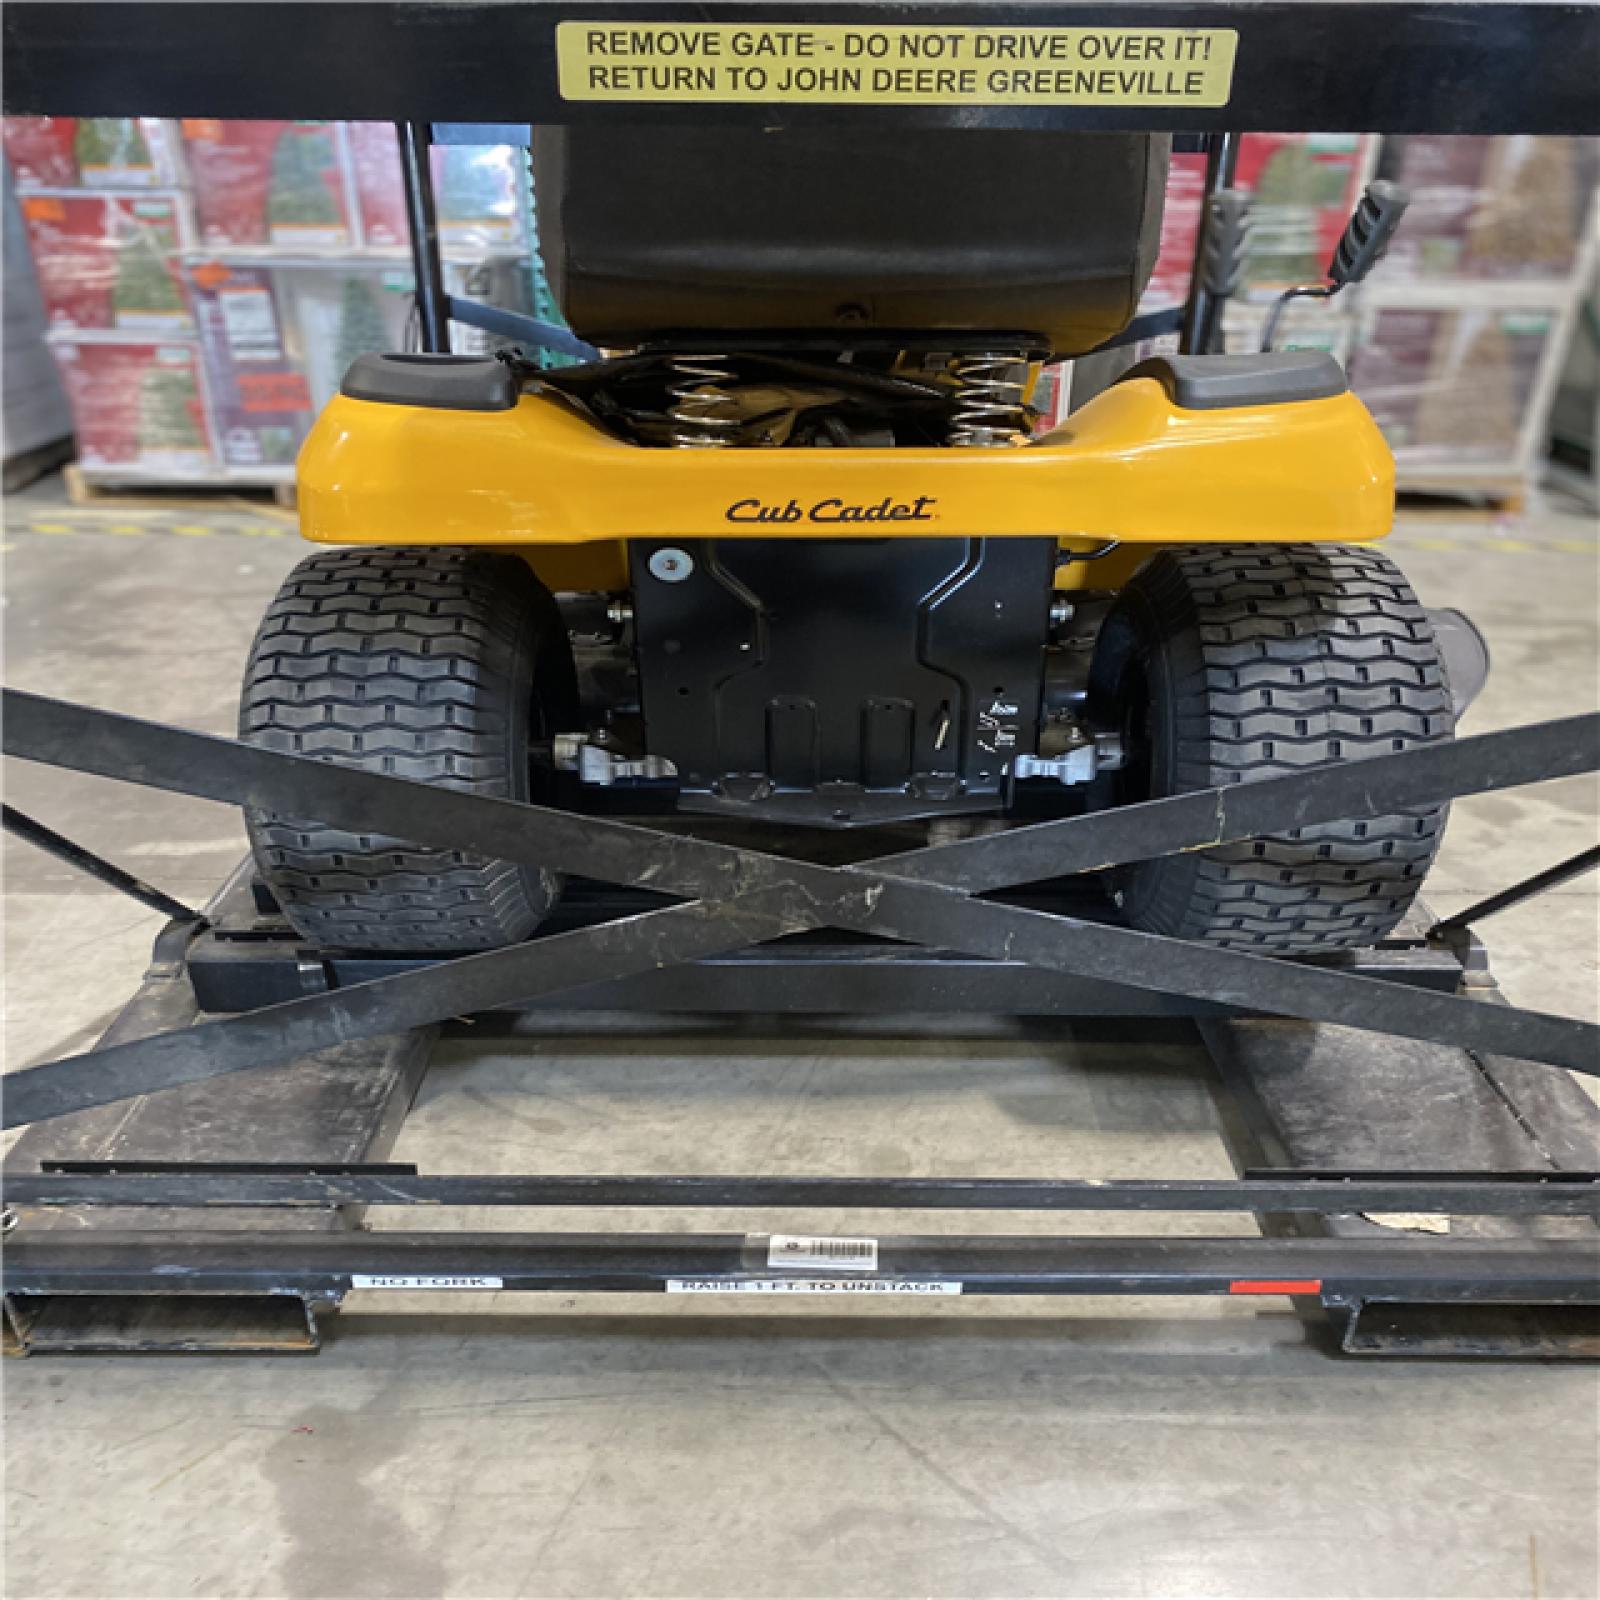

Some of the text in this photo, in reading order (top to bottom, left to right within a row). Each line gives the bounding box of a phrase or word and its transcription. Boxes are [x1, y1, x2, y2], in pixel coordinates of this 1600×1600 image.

[587, 31, 721, 56] REMOVE
[731, 32, 815, 56] GATE
[844, 33, 890, 58] DO
[899, 34, 965, 59] NOT
[974, 34, 1069, 59] DRIVE
[1077, 35, 1167, 60] OVER
[1174, 36, 1212, 61] IT!
[589, 66, 1205, 95] RETURN TO JOHN DEERE GREENEVILLE
[725, 495, 938, 522] Cub Cadet
